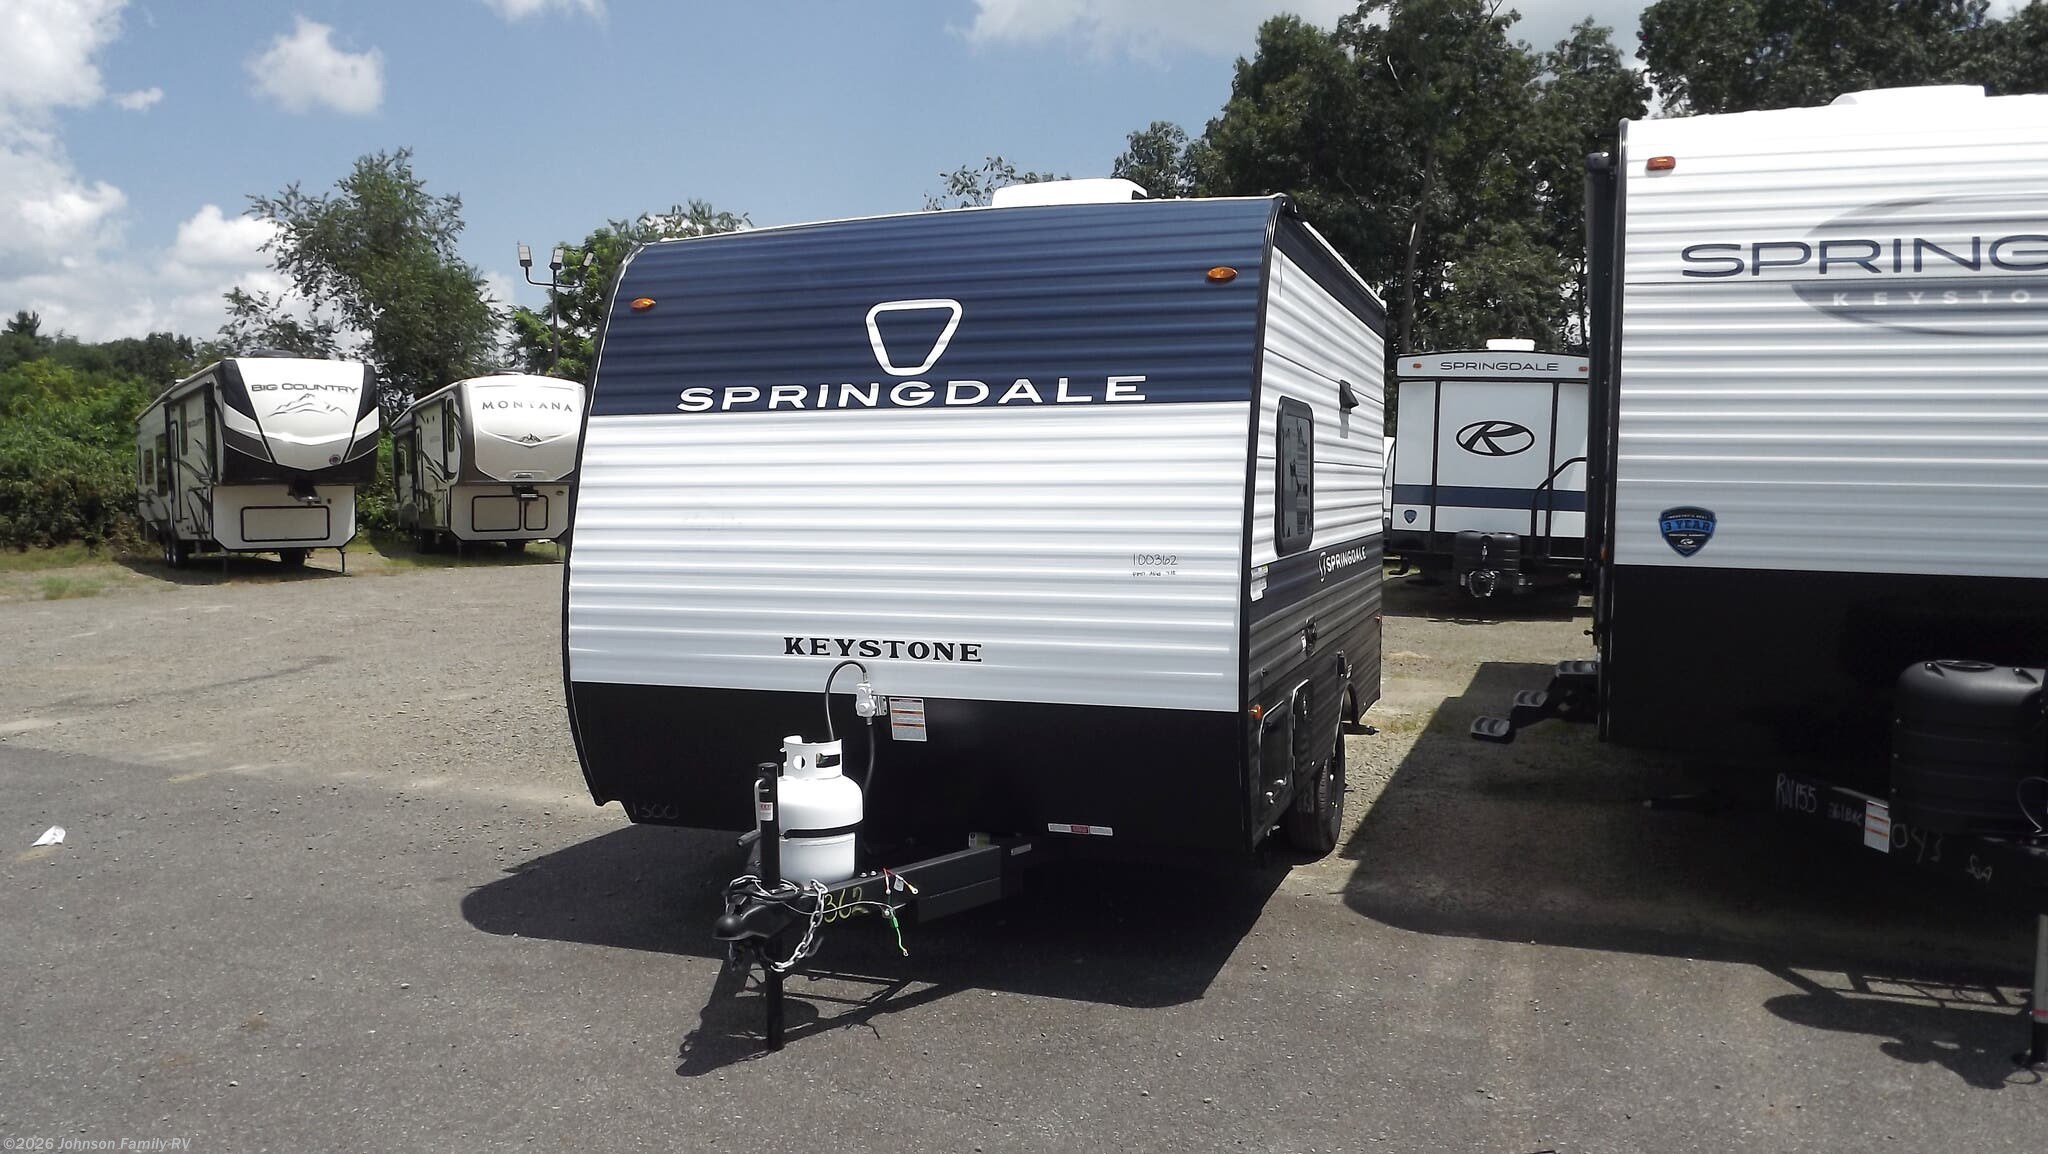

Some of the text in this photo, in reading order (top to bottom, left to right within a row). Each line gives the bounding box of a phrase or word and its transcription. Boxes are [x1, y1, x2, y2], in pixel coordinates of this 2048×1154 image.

[1681, 234, 2048, 278] SPRING
[1440, 361, 1559, 371] SPRINGDALE
[251, 383, 359, 393] BIG COUNTRY
[677, 375, 1148, 412] SPRINGDALE
[482, 400, 573, 413] MONTANA
[1133, 553, 1178, 566] 100362
[1326, 545, 1367, 573] SPRINGDALE
[784, 637, 982, 662] KEYSTONE
[824, 887, 869, 923] 362
